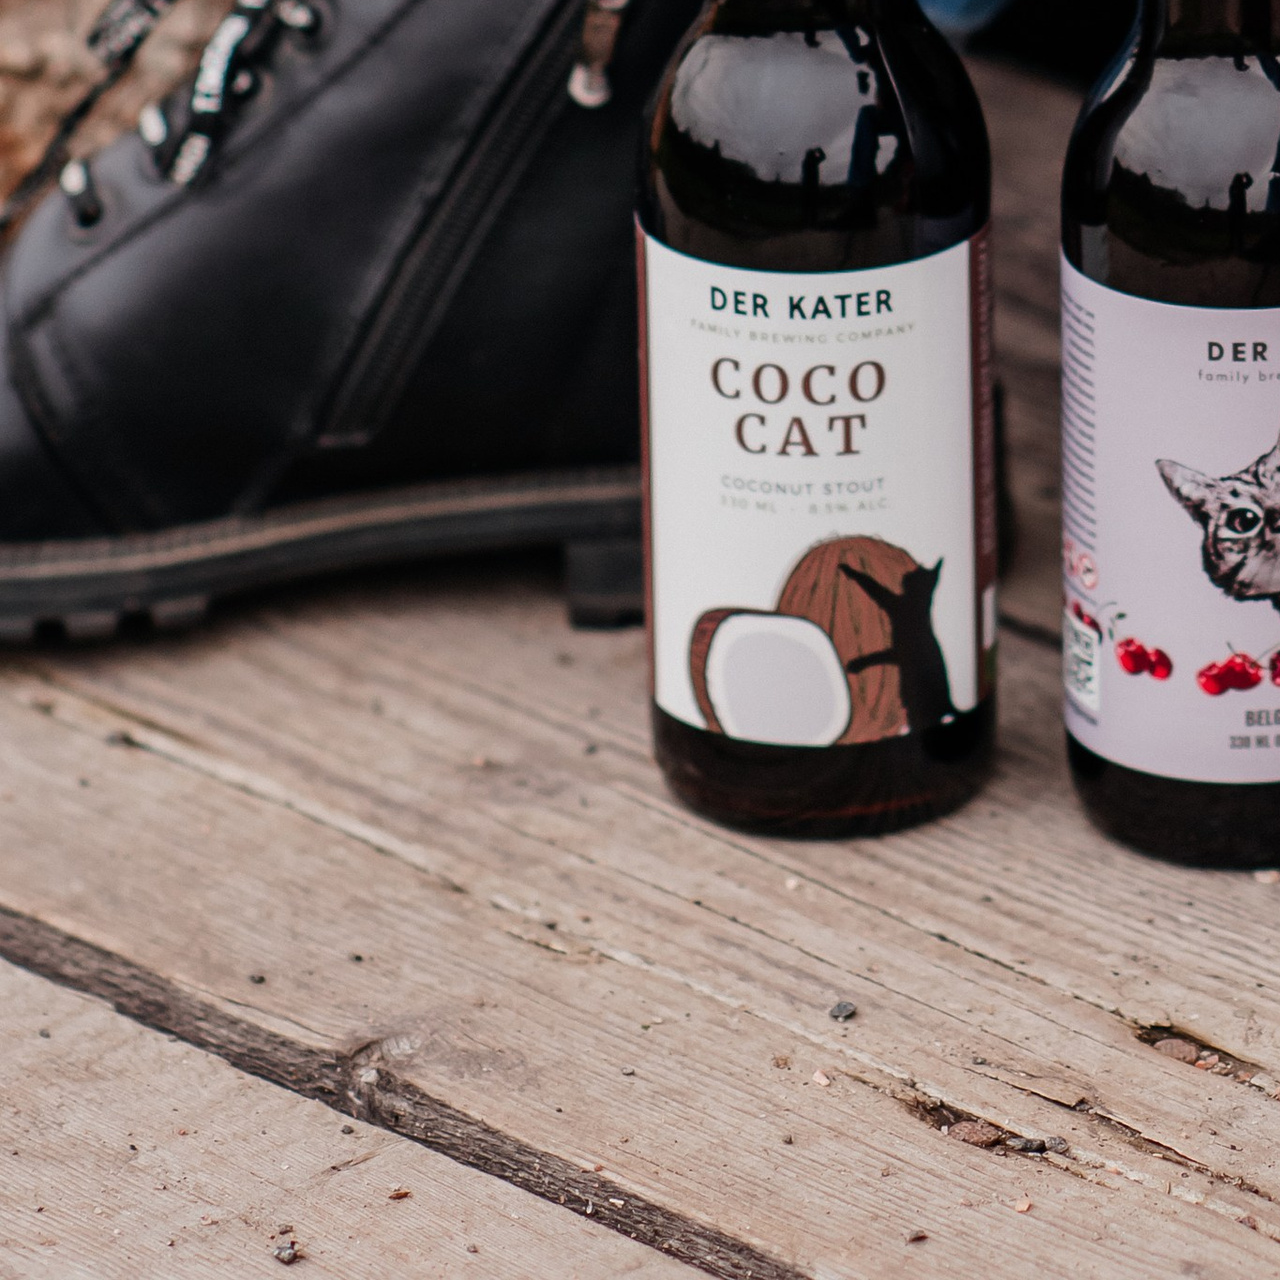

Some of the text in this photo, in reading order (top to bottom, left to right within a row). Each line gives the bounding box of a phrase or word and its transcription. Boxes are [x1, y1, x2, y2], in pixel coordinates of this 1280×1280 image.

[710, 286, 894, 320] DER KATER
[690, 318, 915, 345] FAMILY BREWING COMPANY
[1208, 341, 1268, 363] DER
[710, 357, 887, 406] COCO
[1198, 369, 1249, 384] family
[734, 412, 868, 457] CAT
[721, 474, 884, 496] COCONUT STOUT
